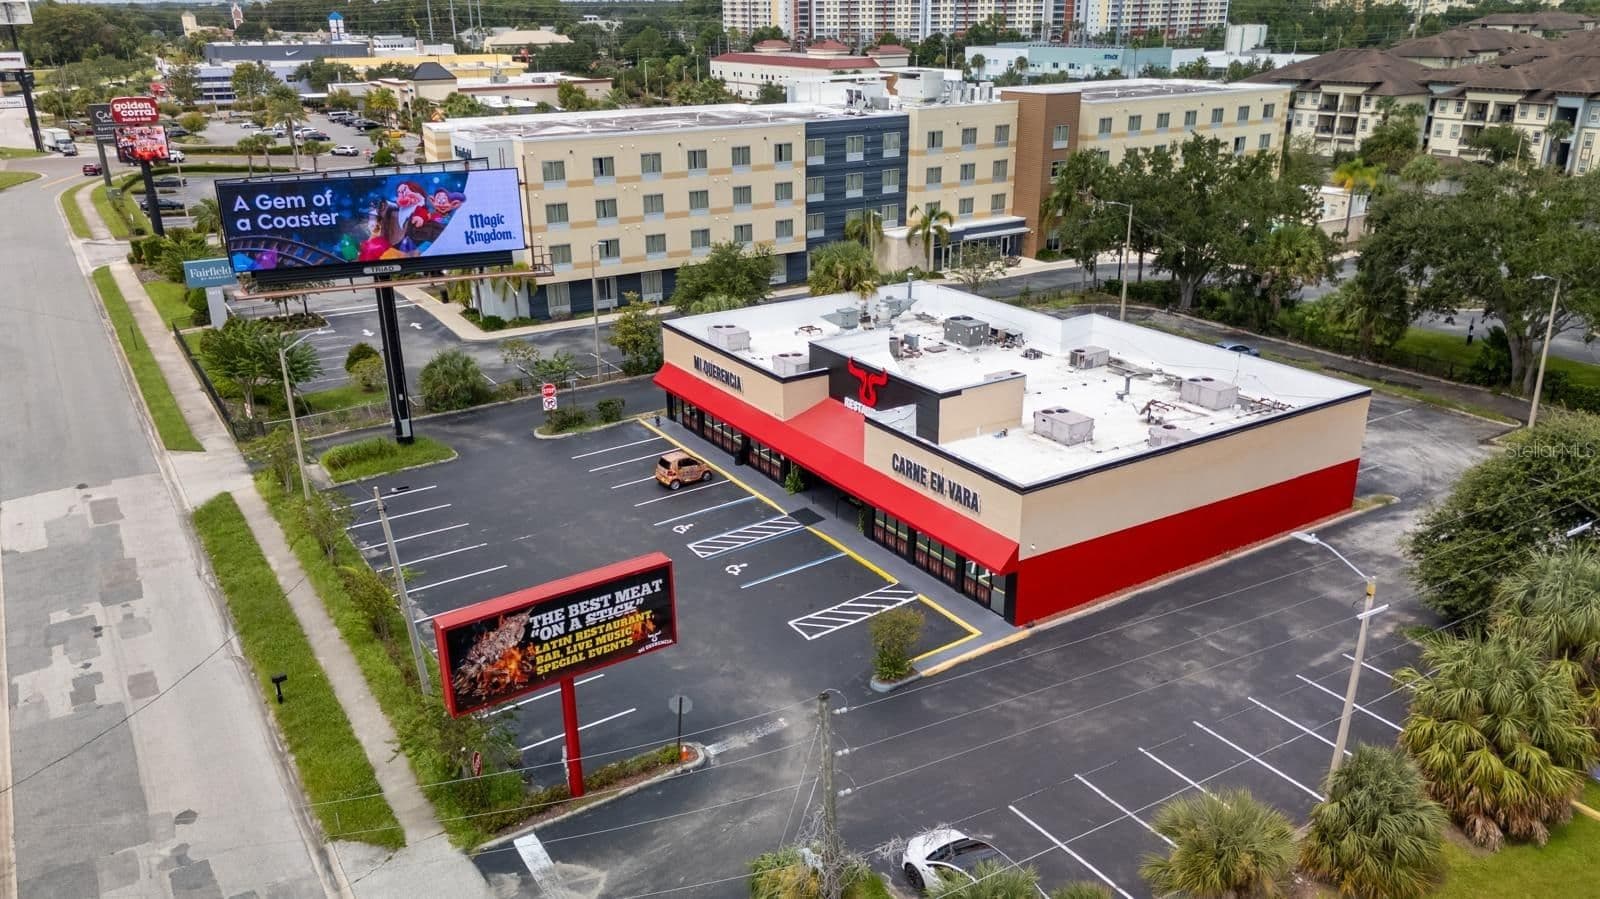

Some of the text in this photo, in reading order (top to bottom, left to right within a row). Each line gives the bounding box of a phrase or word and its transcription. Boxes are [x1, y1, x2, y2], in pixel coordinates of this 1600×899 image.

[113, 101, 152, 112] golden
[121, 108, 157, 117] corral
[233, 189, 333, 212] A Gem of
[236, 211, 339, 231] a Coaster
[469, 213, 505, 229] Magic
[190, 266, 232, 278] Fairfield
[693, 355, 743, 393] MI QUERENCIA
[892, 453, 980, 512] CARNE EN VARA
[529, 579, 663, 629] THE BEST MEAT
[568, 617, 583, 632] A
[535, 634, 574, 655] LATIN
[566, 640, 593, 655] LIVE
[536, 637, 634, 676] SPECIAL EVENTS
